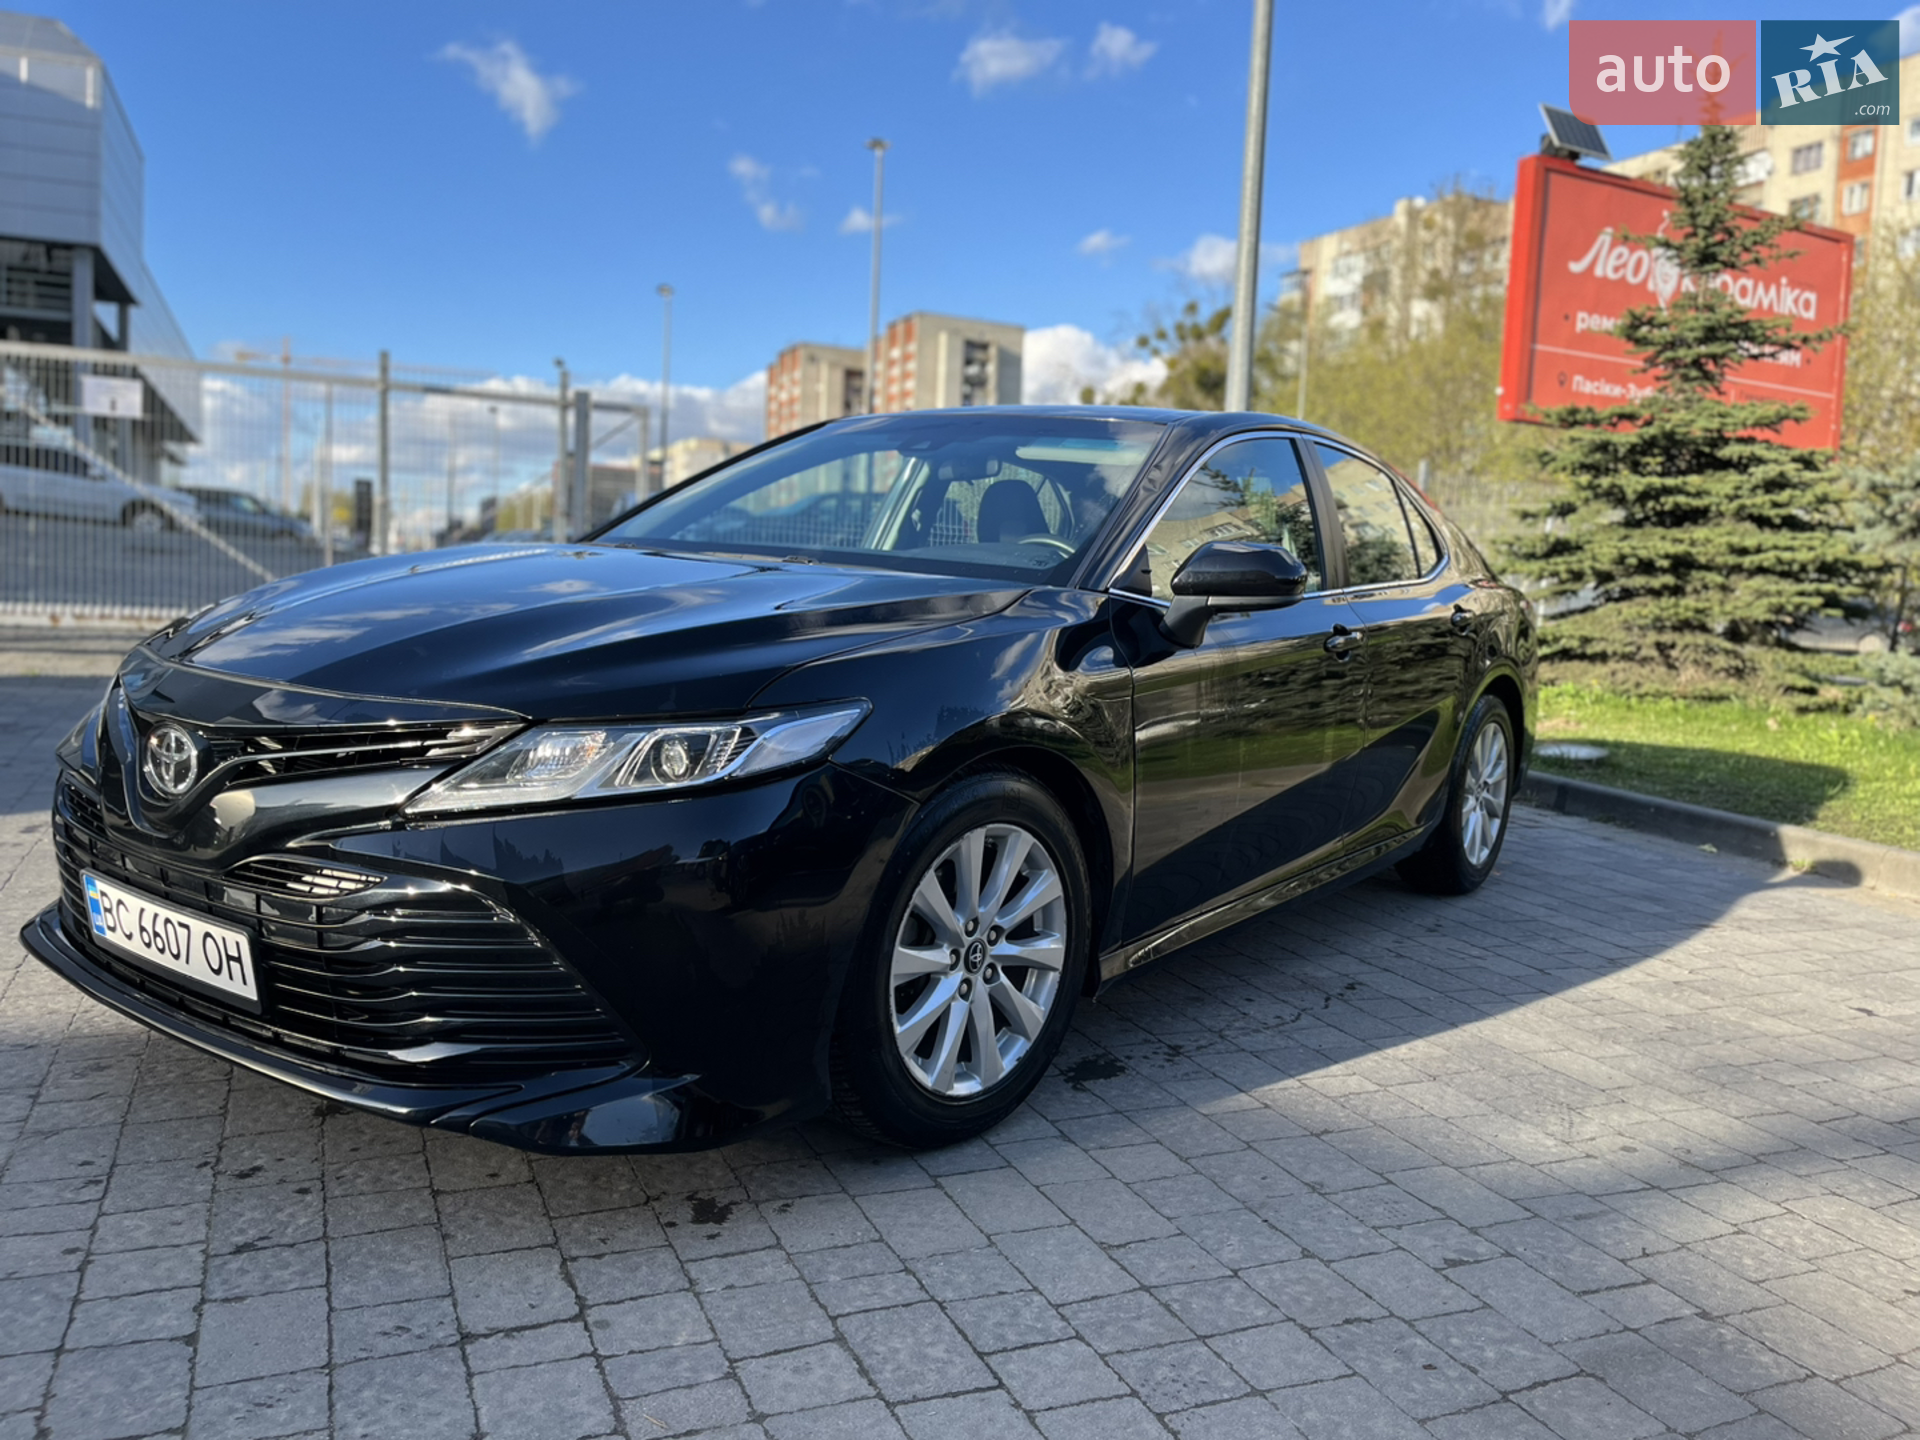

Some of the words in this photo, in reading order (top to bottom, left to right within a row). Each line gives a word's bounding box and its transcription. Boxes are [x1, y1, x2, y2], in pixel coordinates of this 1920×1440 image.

[99, 889, 134, 941] BC
[138, 907, 191, 965] 6607
[202, 930, 248, 986] OH
